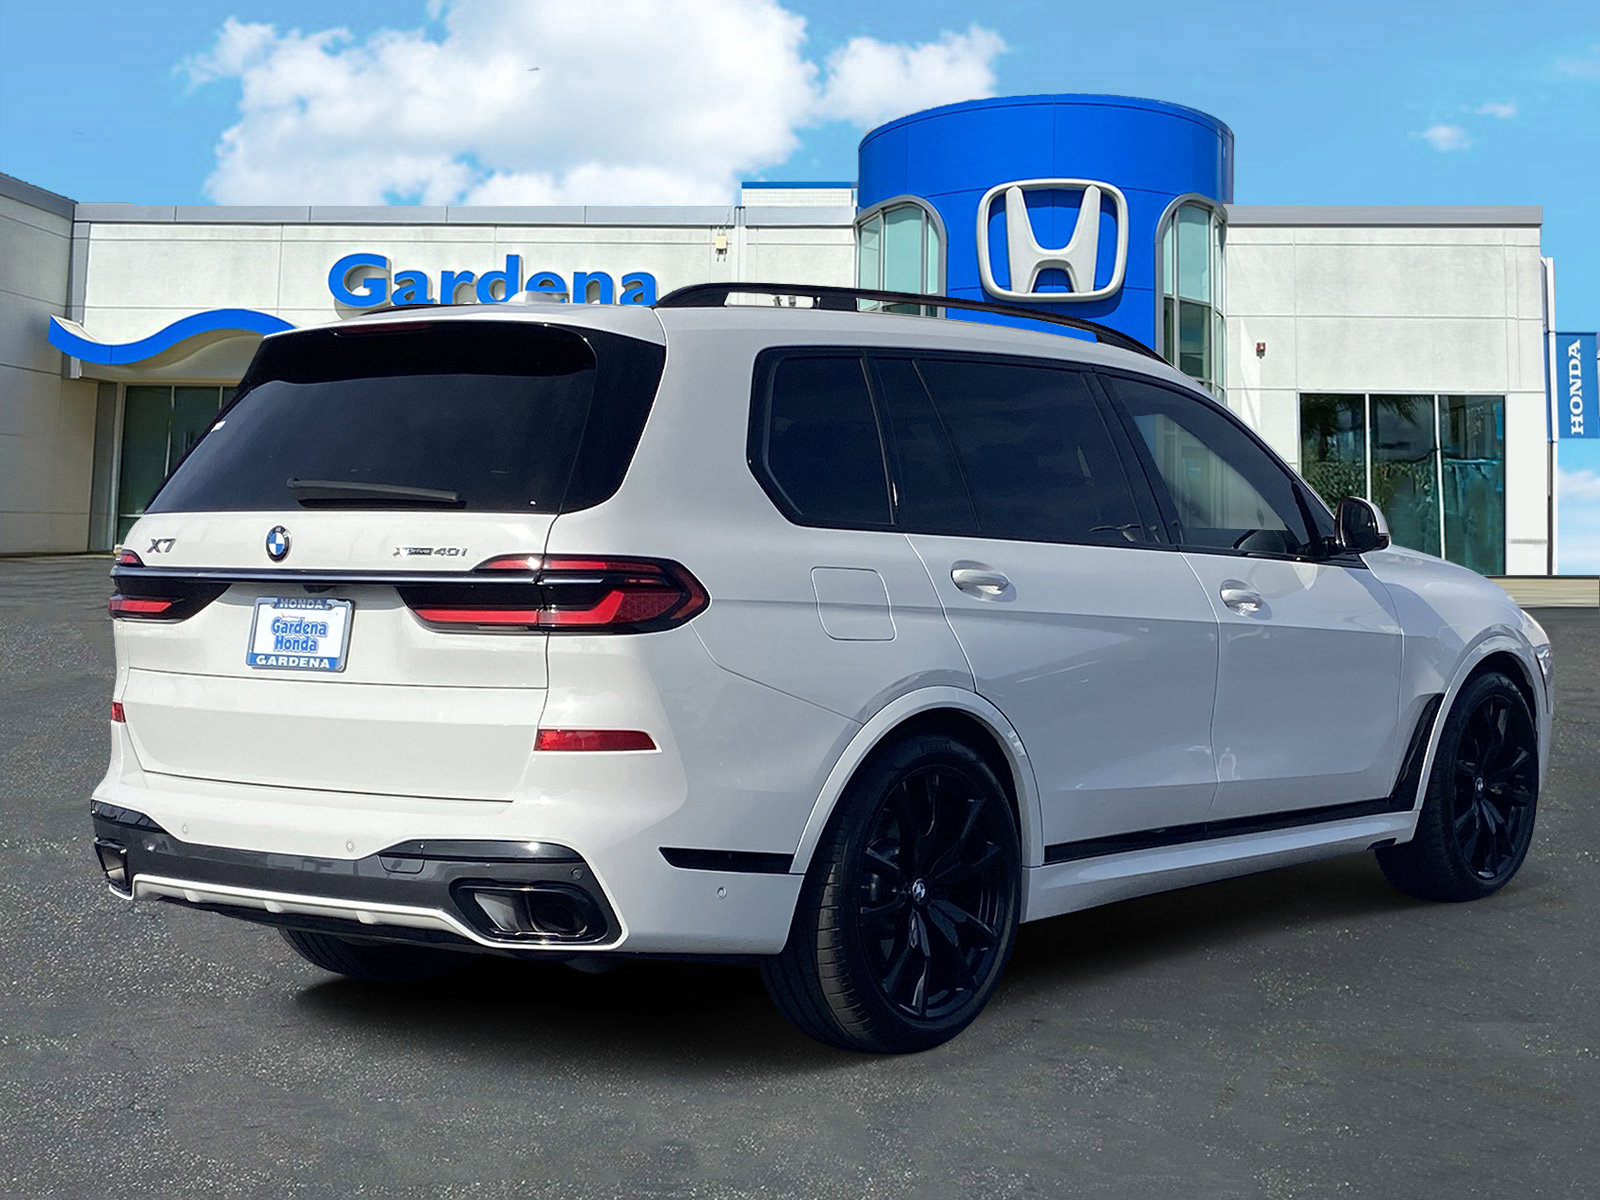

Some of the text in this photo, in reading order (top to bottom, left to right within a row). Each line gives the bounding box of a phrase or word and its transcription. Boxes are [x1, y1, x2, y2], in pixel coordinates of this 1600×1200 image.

[328, 252, 656, 307] Gardena
[1568, 339, 1584, 435] HONDA
[146, 538, 177, 553] X7
[279, 599, 323, 608] HONDA
[271, 617, 328, 636] Gardena
[274, 635, 318, 652] Honda
[255, 655, 330, 668] GARDENA
